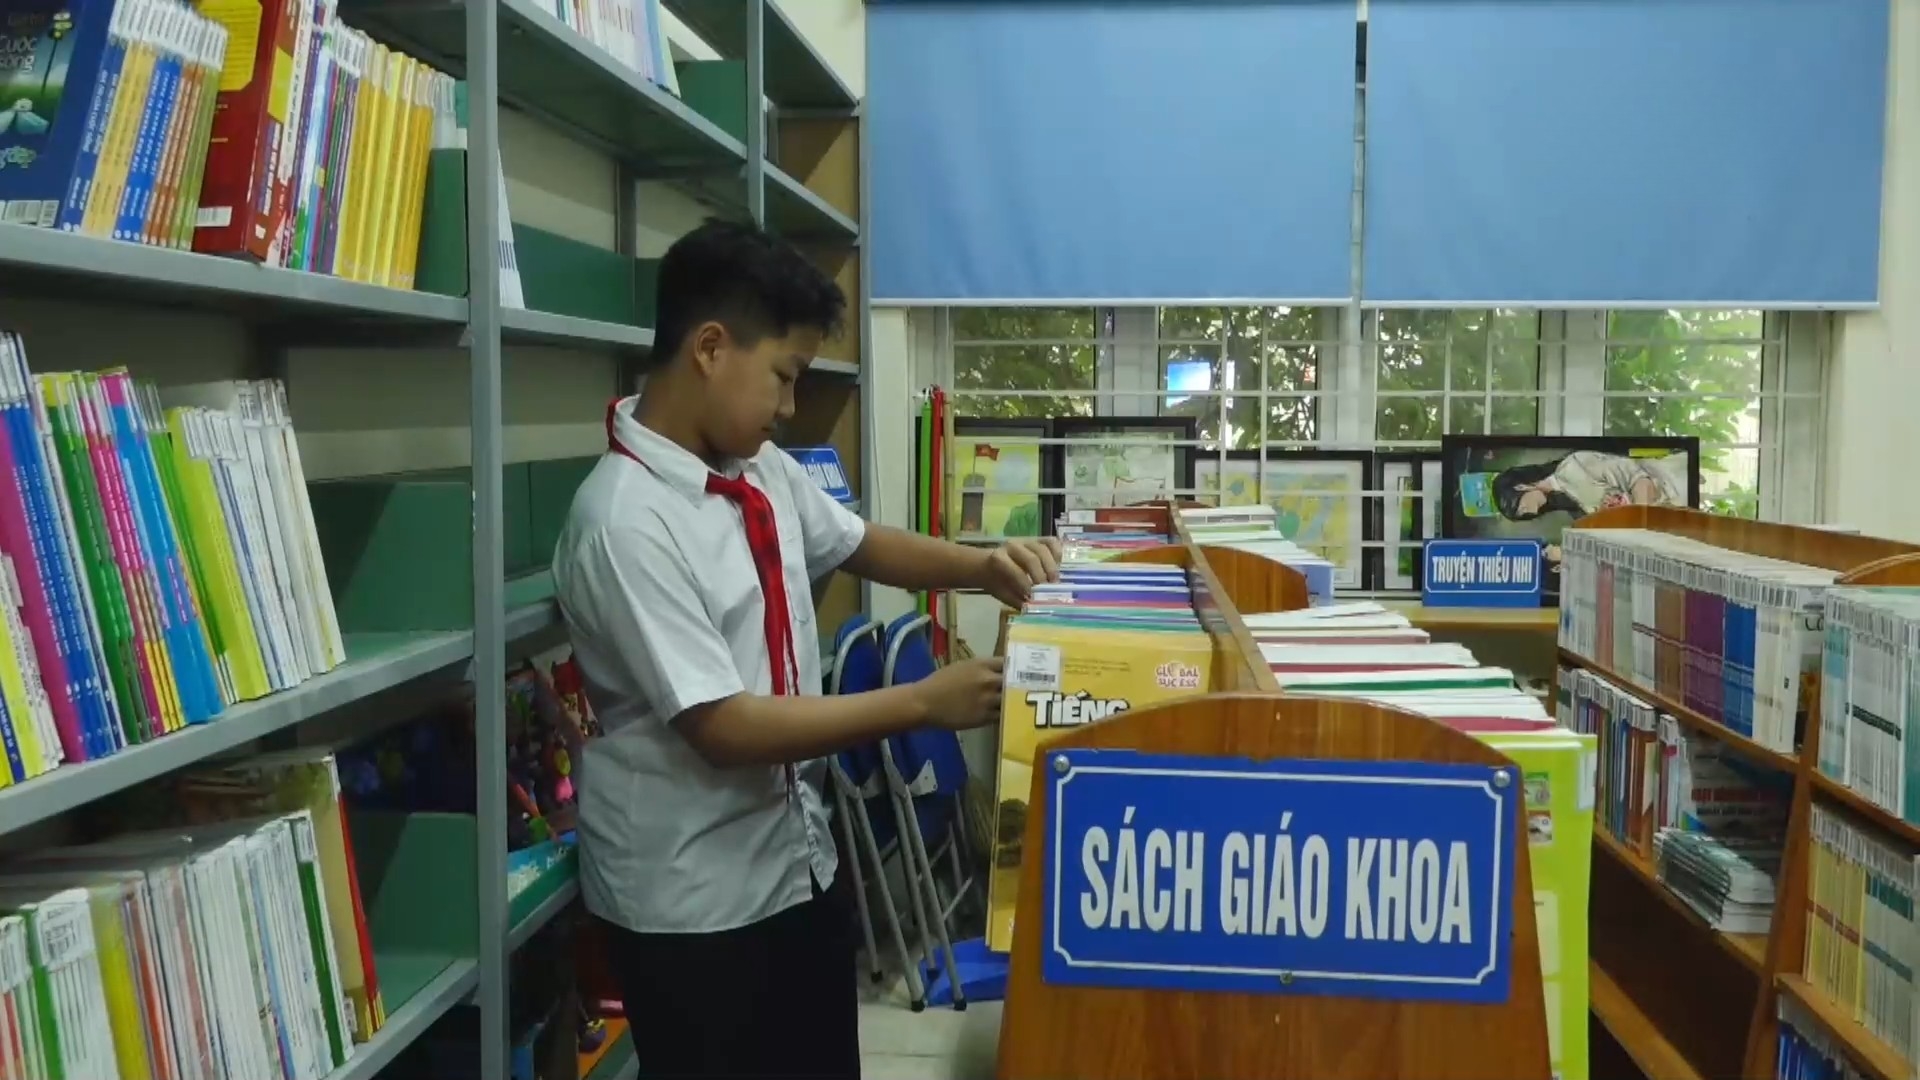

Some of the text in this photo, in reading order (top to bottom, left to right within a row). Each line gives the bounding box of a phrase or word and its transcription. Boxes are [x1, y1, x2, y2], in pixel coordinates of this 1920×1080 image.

[1432, 546, 1533, 589] TRUYỆN THIẾU NHI
[1080, 806, 1472, 944] SÁCH GIÁO KHOA
